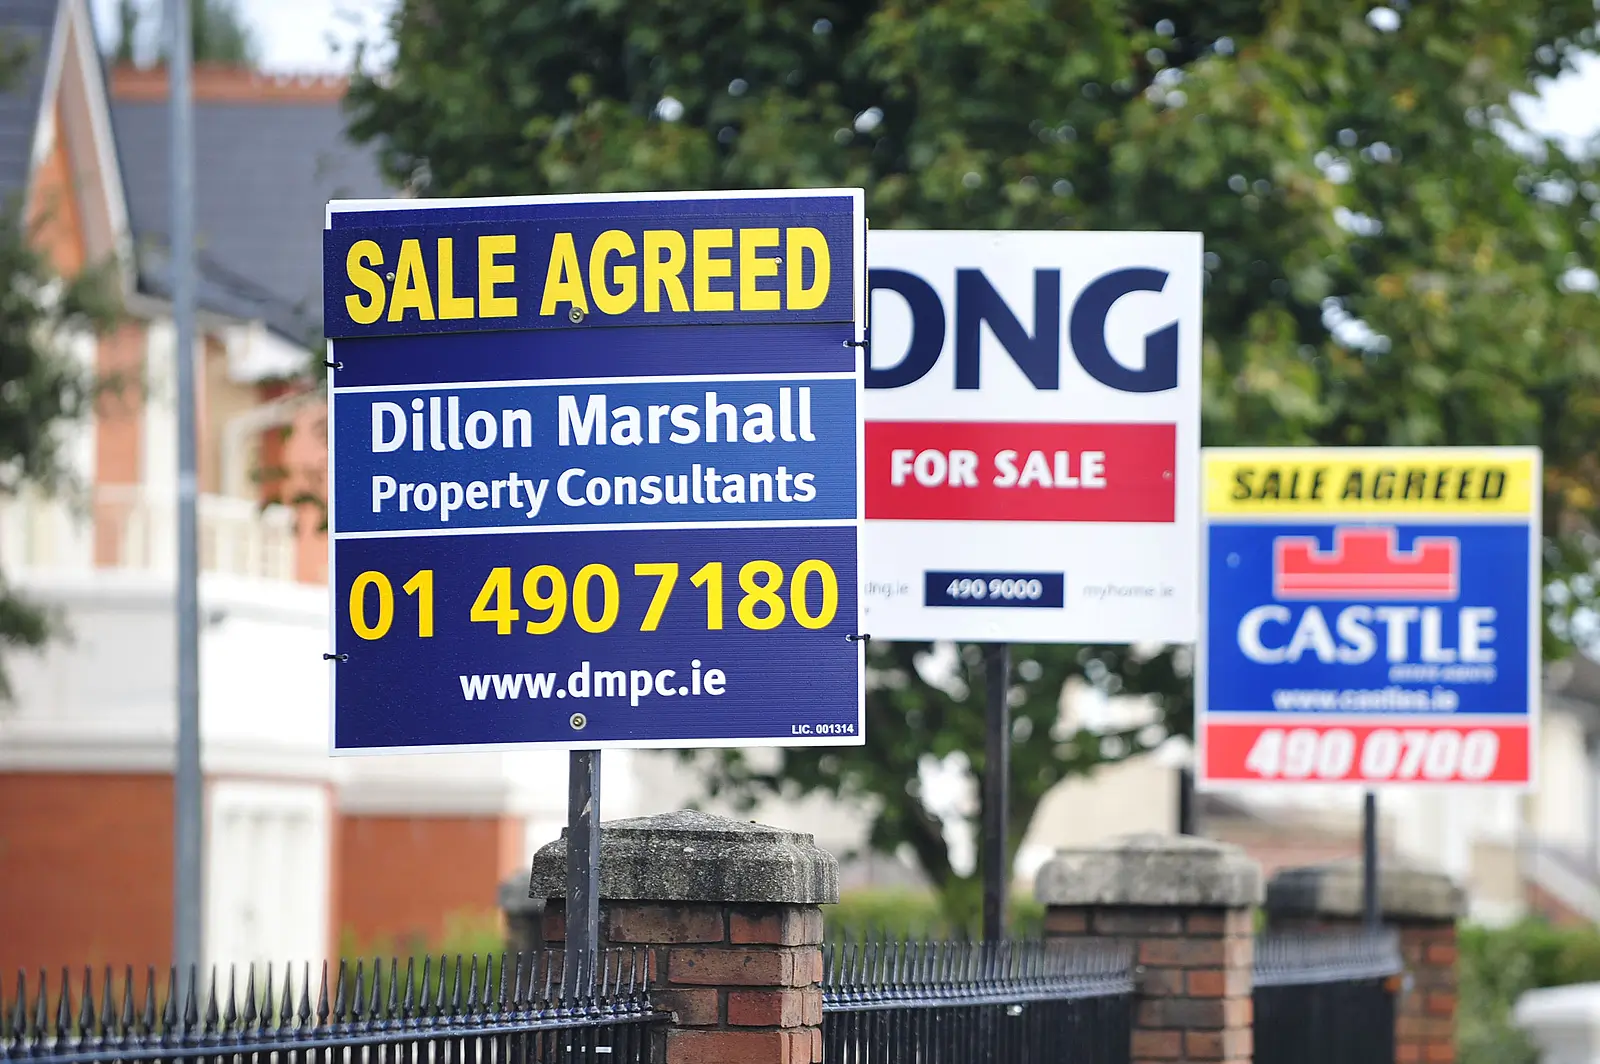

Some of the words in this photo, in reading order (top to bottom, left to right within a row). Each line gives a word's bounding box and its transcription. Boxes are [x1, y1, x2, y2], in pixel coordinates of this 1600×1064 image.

[345, 234, 518, 325] SALE
[539, 226, 831, 317] AGREED
[864, 266, 1179, 393] DNG
[371, 395, 533, 454] Dillon
[557, 387, 816, 447] Marshall
[371, 472, 549, 523] Property
[556, 464, 817, 508] Consultants
[889, 448, 980, 488] FOR
[992, 448, 1107, 489] SALE
[1230, 467, 1328, 501] SALE
[1339, 467, 1509, 501] AGREED
[348, 570, 435, 640] 01
[469, 563, 620, 635] 490
[634, 559, 839, 632] 7180
[945, 578, 987, 600] 490
[988, 578, 1044, 600] 9000
[1082, 581, 1176, 604] myhome.ie
[1236, 604, 1498, 664] CASTLE
[458, 659, 727, 706] www.dmpc.ie
[791, 724, 814, 735] LIC.
[815, 723, 855, 734] 001314
[1245, 728, 1355, 780] 490
[1360, 729, 1500, 780] 0700
